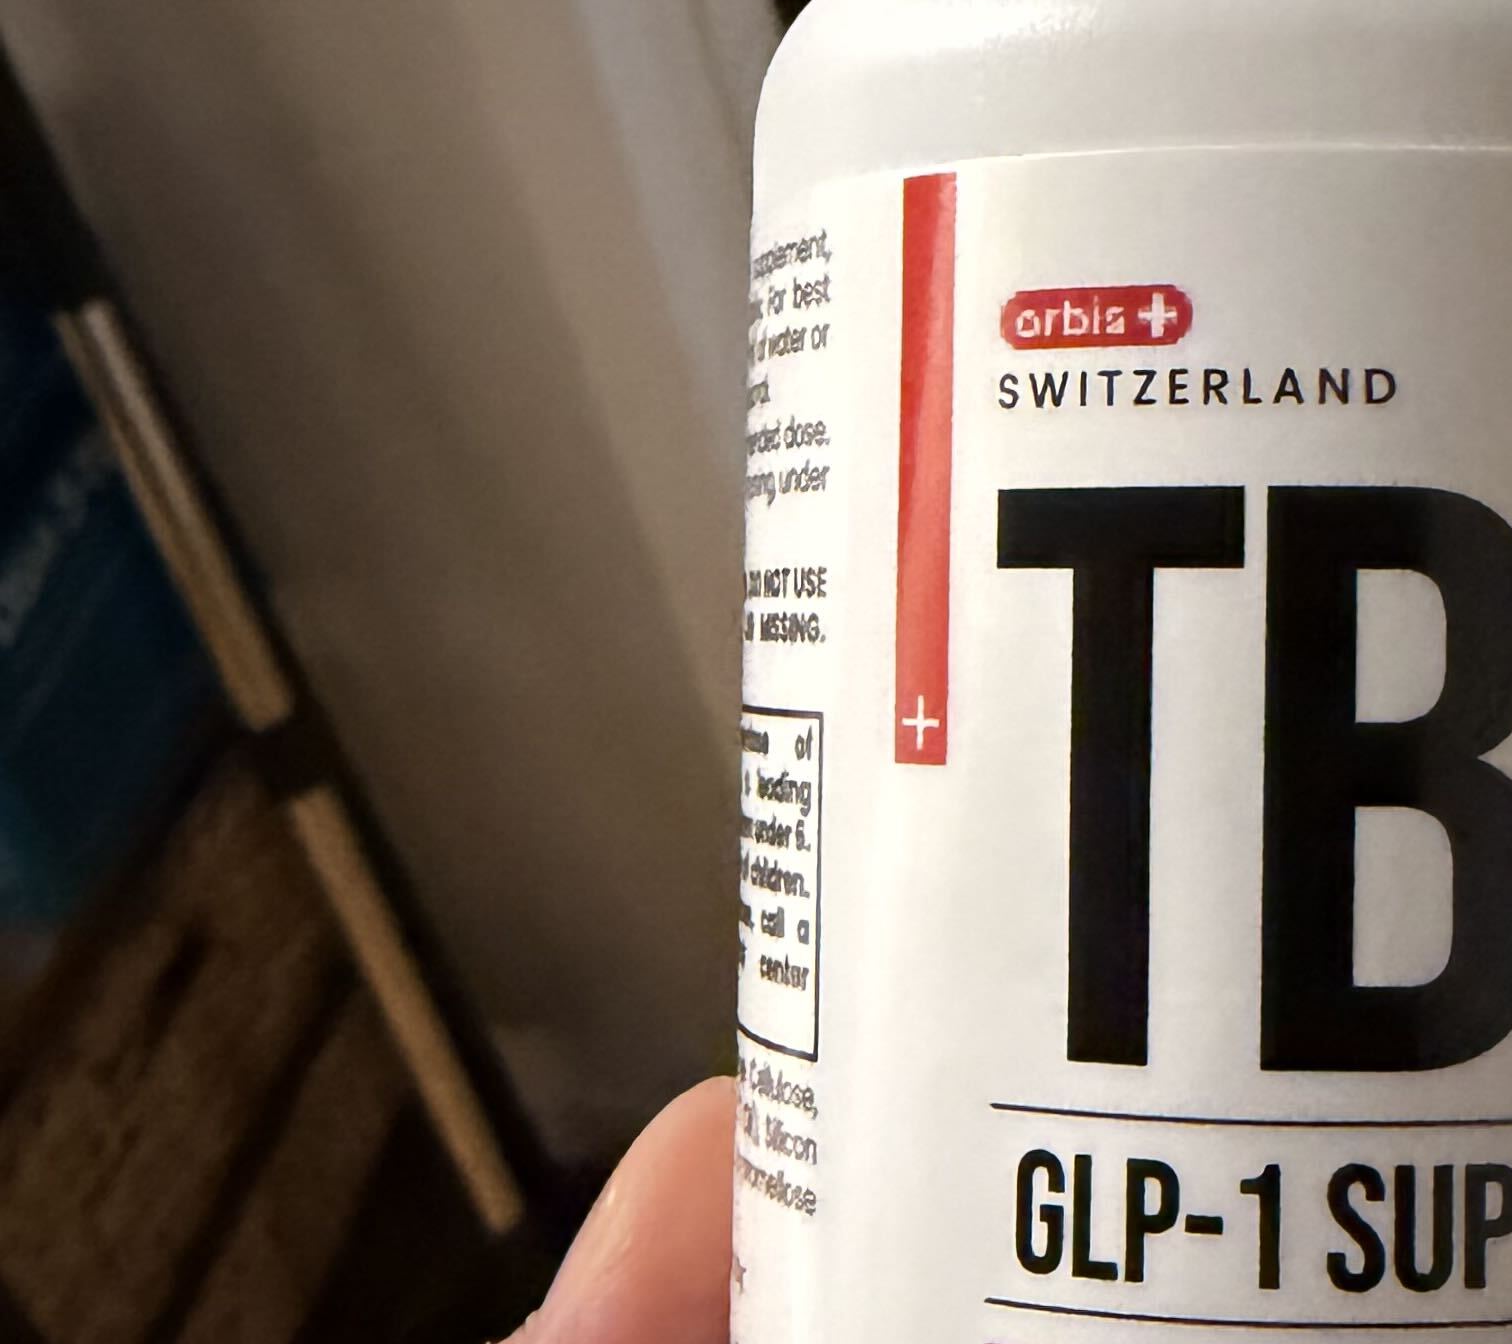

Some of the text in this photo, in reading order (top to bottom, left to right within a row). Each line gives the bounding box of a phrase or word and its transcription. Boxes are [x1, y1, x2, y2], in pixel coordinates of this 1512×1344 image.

[793, 273, 830, 310] best
[1015, 296, 1125, 338] orbis
[811, 323, 831, 351] or
[999, 367, 1398, 410] SWITZERLAND
[778, 458, 830, 494] under
[794, 565, 828, 599] USE
[794, 724, 813, 761] of
[1015, 1148, 1283, 1291] GLP-1
